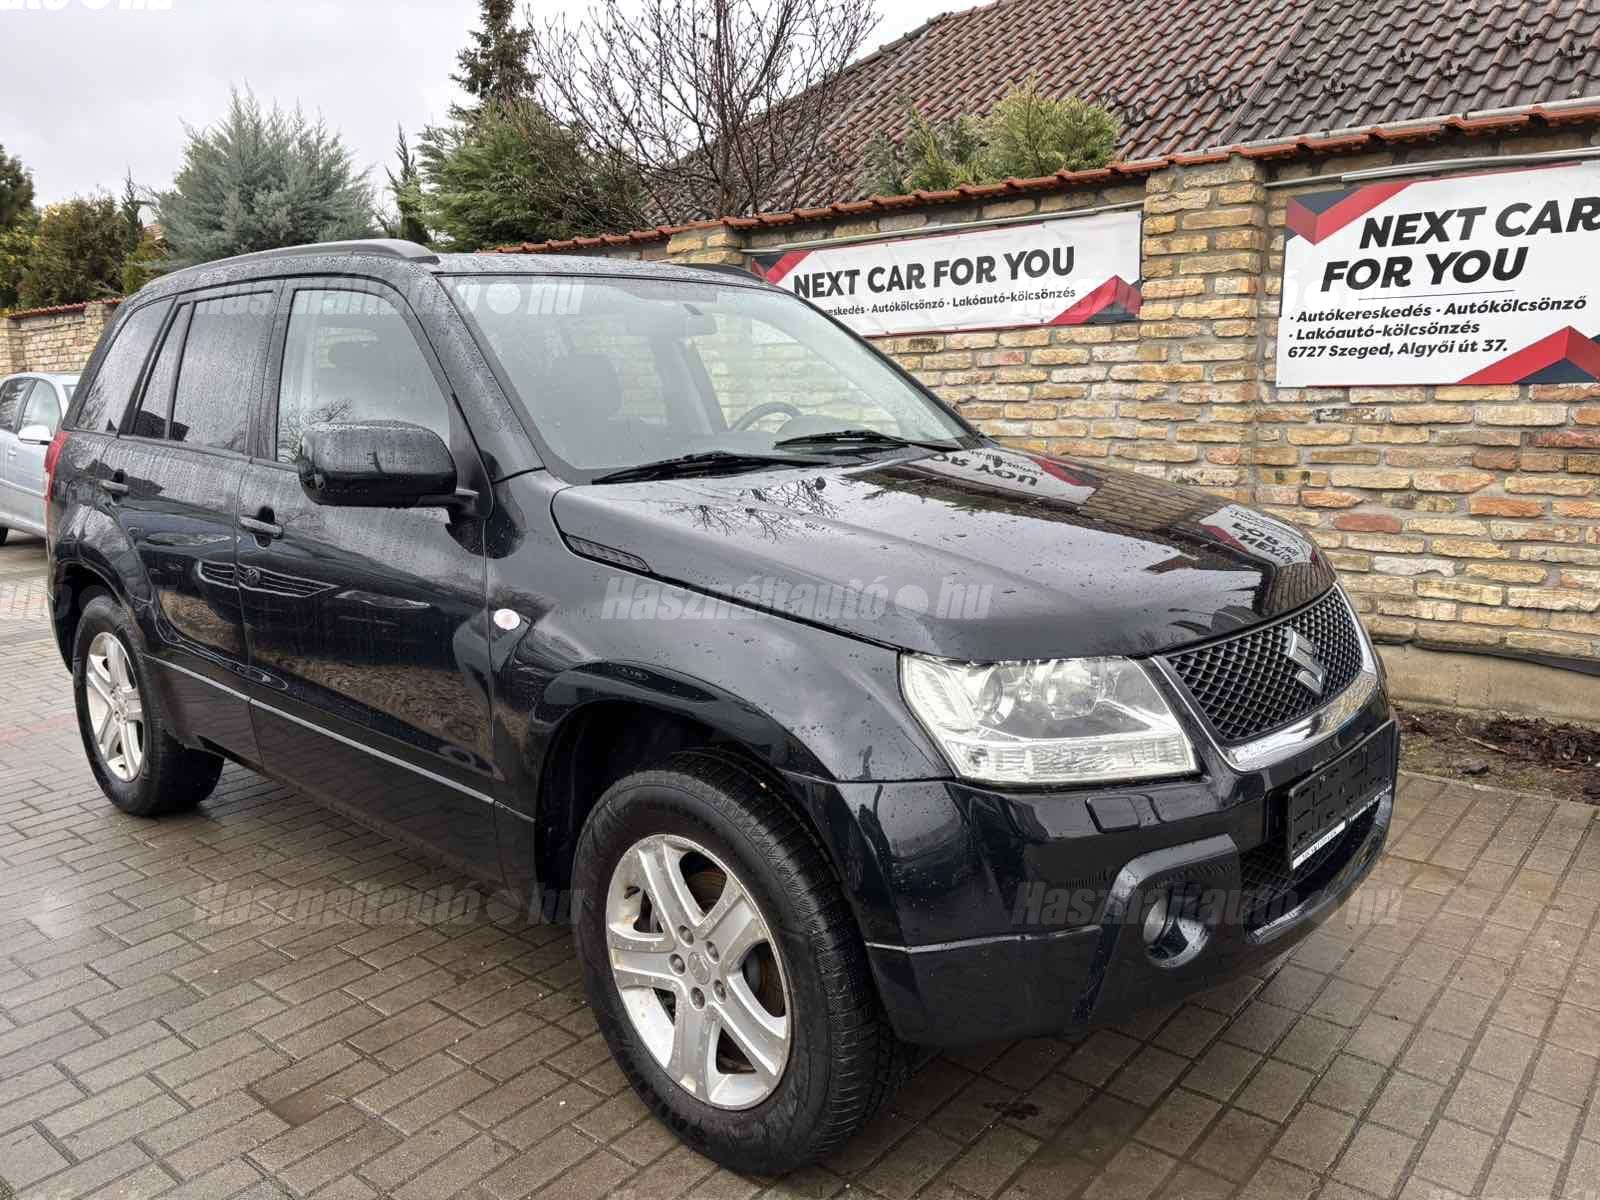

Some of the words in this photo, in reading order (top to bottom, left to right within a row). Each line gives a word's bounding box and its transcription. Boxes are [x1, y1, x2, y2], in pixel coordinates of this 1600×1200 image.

[1359, 206, 1487, 249] NEXT
[1495, 197, 1600, 237] CAR
[793, 269, 860, 298] NEXT
[867, 263, 926, 293] CAR
[933, 256, 996, 287] FOR
[1003, 246, 1075, 280] YOU
[1320, 256, 1413, 292] FOR
[1425, 246, 1529, 286] YOU
[825, 304, 865, 316] eskedés
[952, 288, 1076, 308] Lakóautó-kölcsönzés
[1296, 304, 1432, 322] Autókereskedés
[1443, 295, 1587, 316] Autókölcsönző
[1296, 320, 1480, 340] Lakóautó-kölcsönzés
[1287, 345, 1327, 358] 6727
[1328, 343, 1394, 360] Szeged,
[1397, 340, 1455, 358] Algyői
[1458, 339, 1478, 353] út
[1482, 339, 1508, 352] 37.
